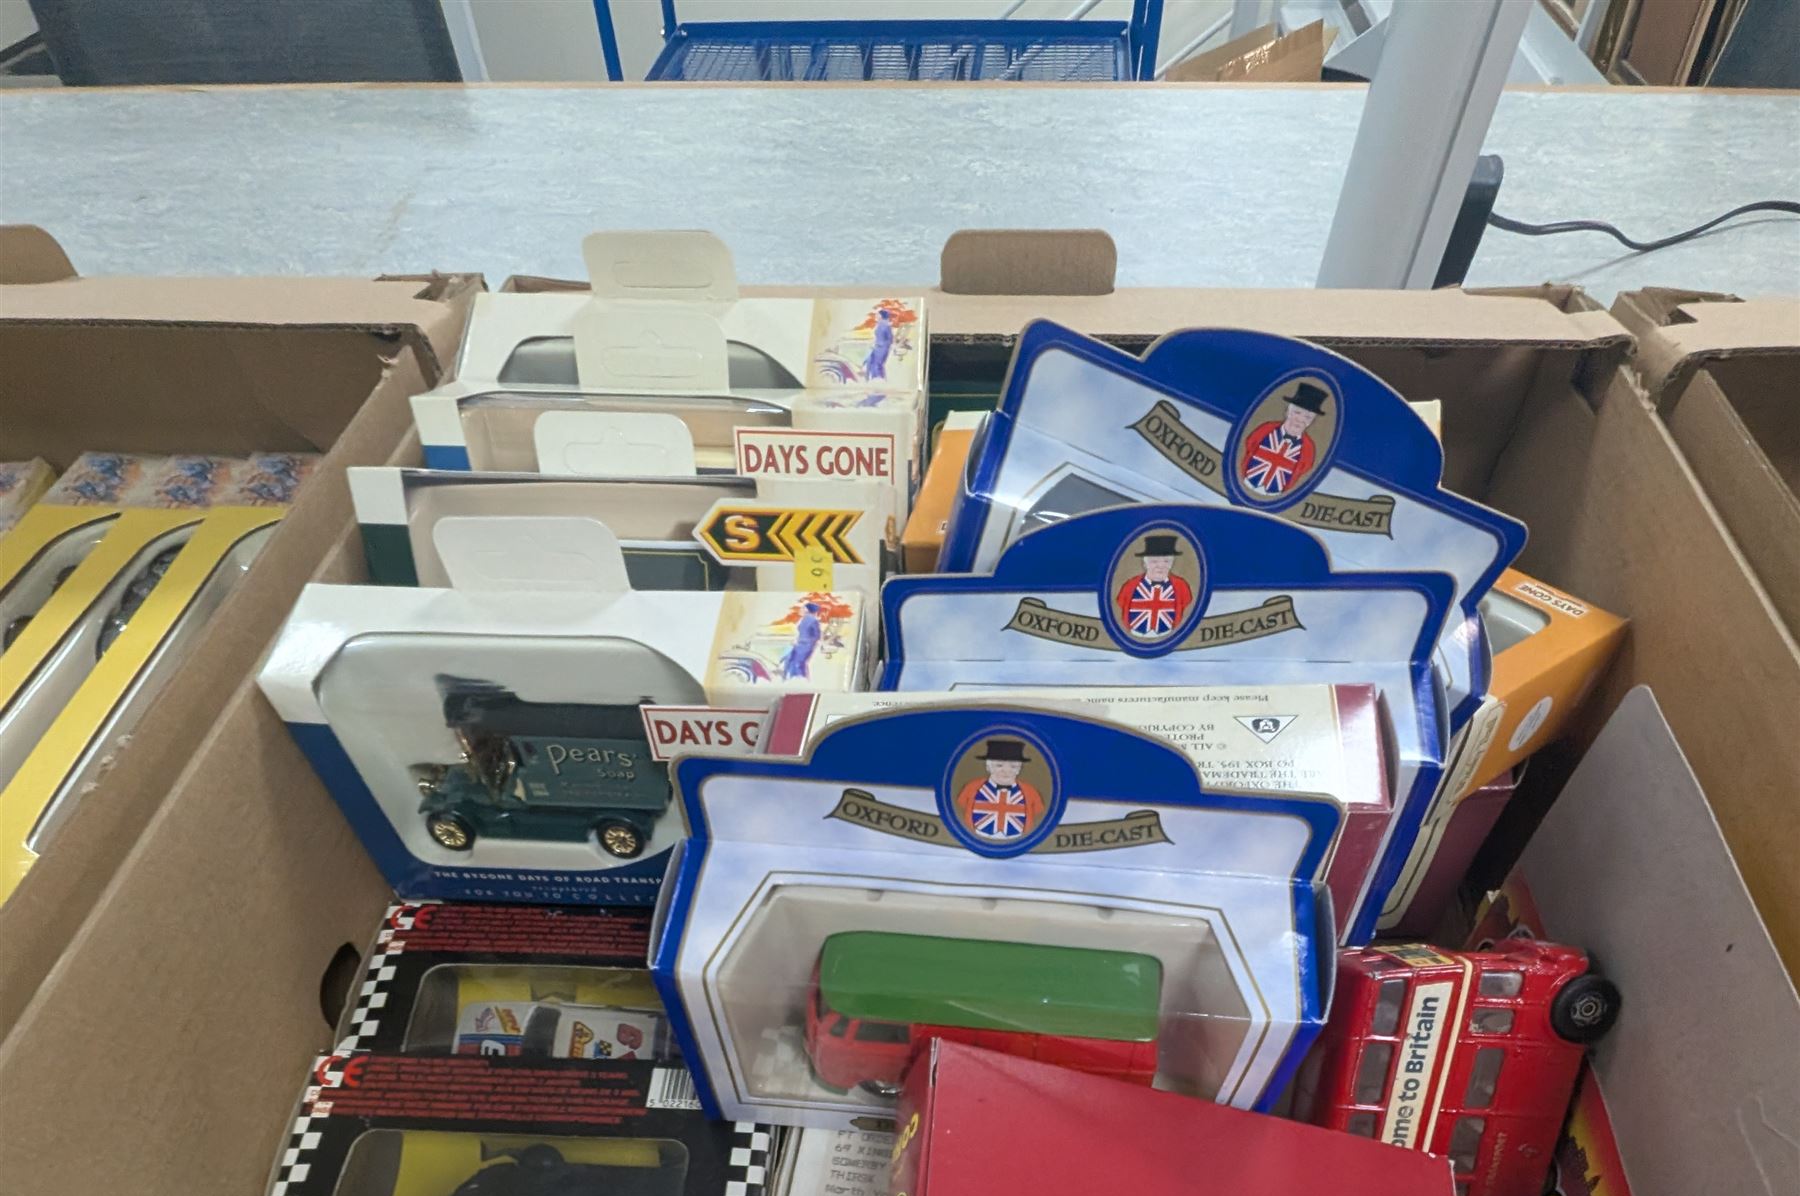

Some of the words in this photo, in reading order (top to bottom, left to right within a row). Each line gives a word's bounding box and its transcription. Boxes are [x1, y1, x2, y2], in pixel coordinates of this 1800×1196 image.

[744, 444, 810, 475] DAYS
[816, 446, 889, 476] GONE
[1145, 415, 1217, 476] OXFORD
[1300, 502, 1391, 528] DIE-CAST
[725, 515, 761, 552] S
[1551, 600, 1584, 616] DAYS
[1017, 611, 1099, 642] OXFORD
[1201, 609, 1290, 642] DIE-CAST
[1117, 695, 1199, 706] manufacturers
[1202, 693, 1230, 704] keep
[1233, 694, 1269, 704] Please
[654, 720, 734, 747] DAYS
[1197, 723, 1214, 732] BY
[1245, 759, 1273, 769] BOX
[842, 800, 939, 838] OXFORD
[1055, 823, 1156, 849] DIE-CAST
[434, 871, 459, 880] THE
[463, 872, 513, 881] BYGONE
[518, 874, 550, 882] DAYS
[554, 875, 570, 883] OF
[577, 876, 610, 884] ROAD
[1404, 996, 1440, 1074] Britain
[1397, 1077, 1421, 1102] to
